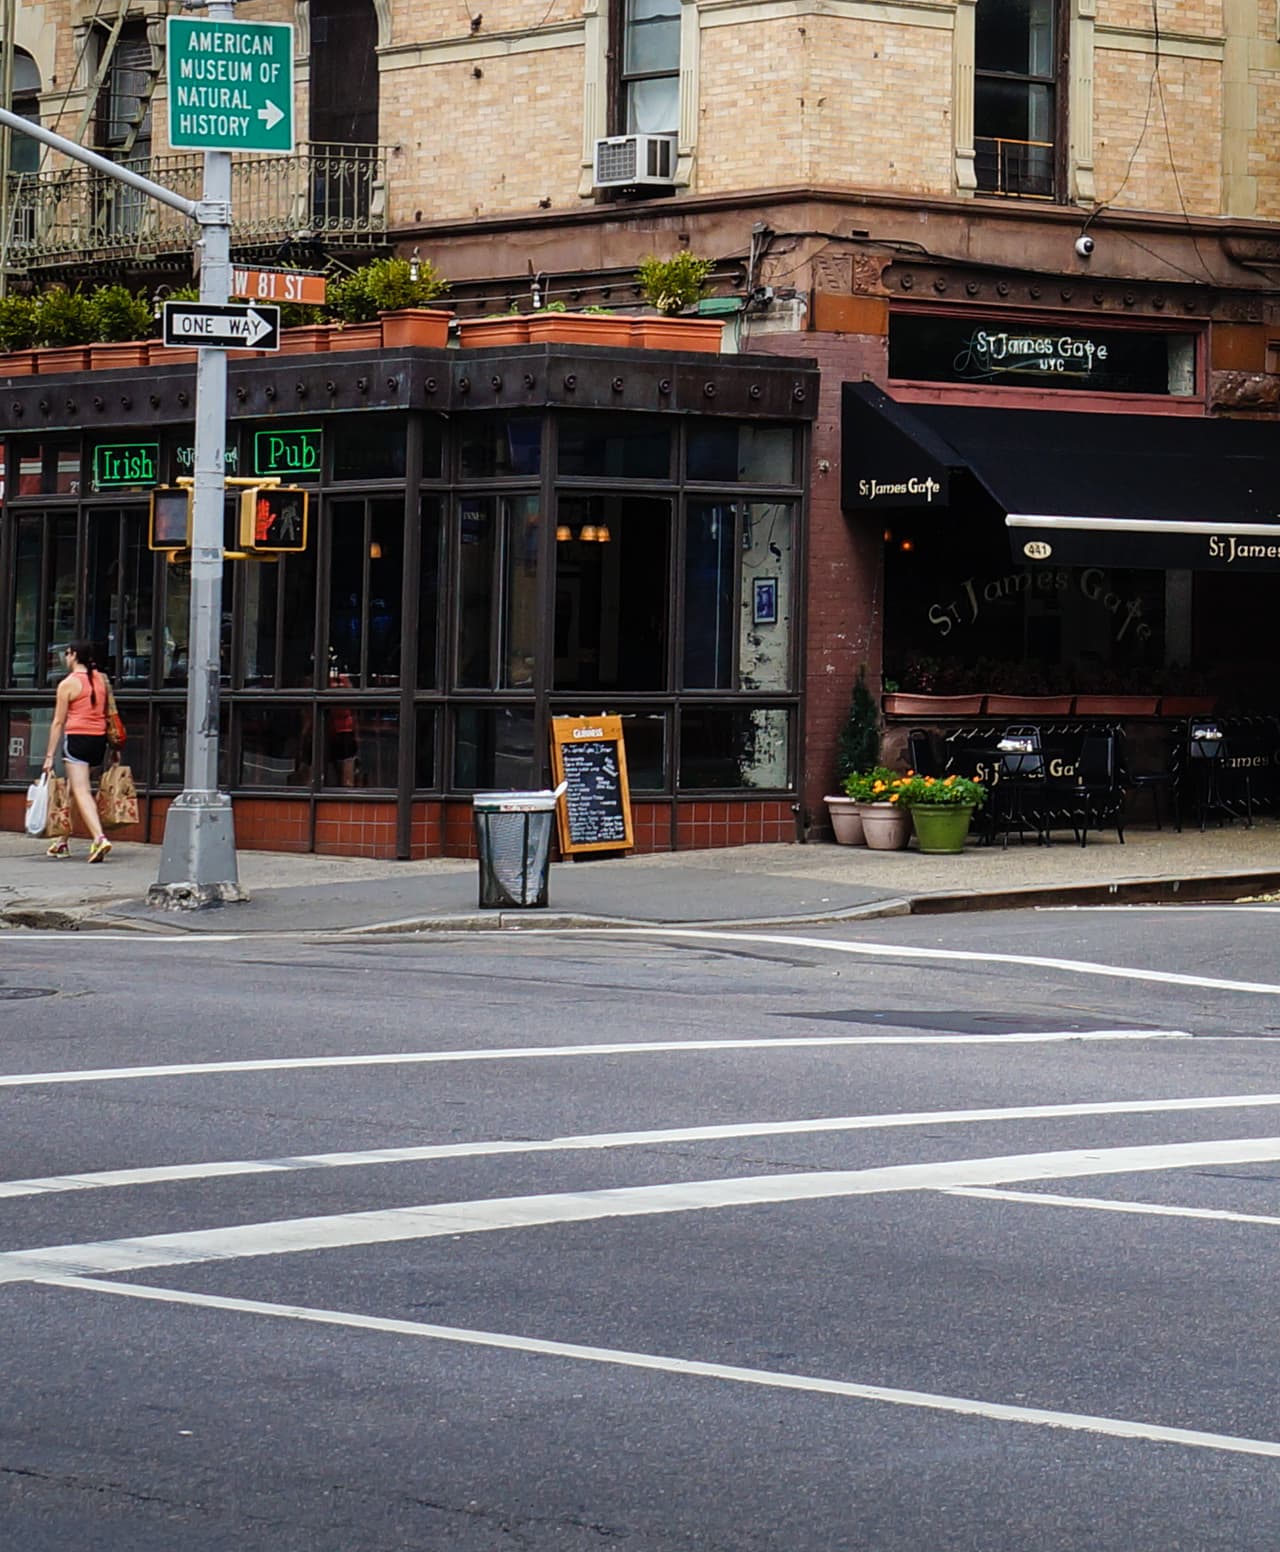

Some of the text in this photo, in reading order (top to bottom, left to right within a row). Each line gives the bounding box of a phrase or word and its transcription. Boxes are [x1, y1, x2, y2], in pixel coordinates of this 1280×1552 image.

[188, 31, 273, 55] AMERICAN
[180, 58, 280, 83] MUSEUM OF
[177, 86, 252, 109] NATURAL
[180, 113, 250, 136] HISTORY
[234, 271, 304, 300] W 81 ST
[182, 317, 261, 336] ONE WAY
[993, 333, 1053, 359] James
[1058, 336, 1108, 373] Gate
[1039, 358, 1065, 372] NYC
[268, 436, 316, 468] Pub
[103, 450, 153, 480] Irish
[870, 479, 907, 499] James
[908, 477, 940, 502] Gate
[1028, 543, 1047, 556] 441
[961, 569, 1069, 624] James
